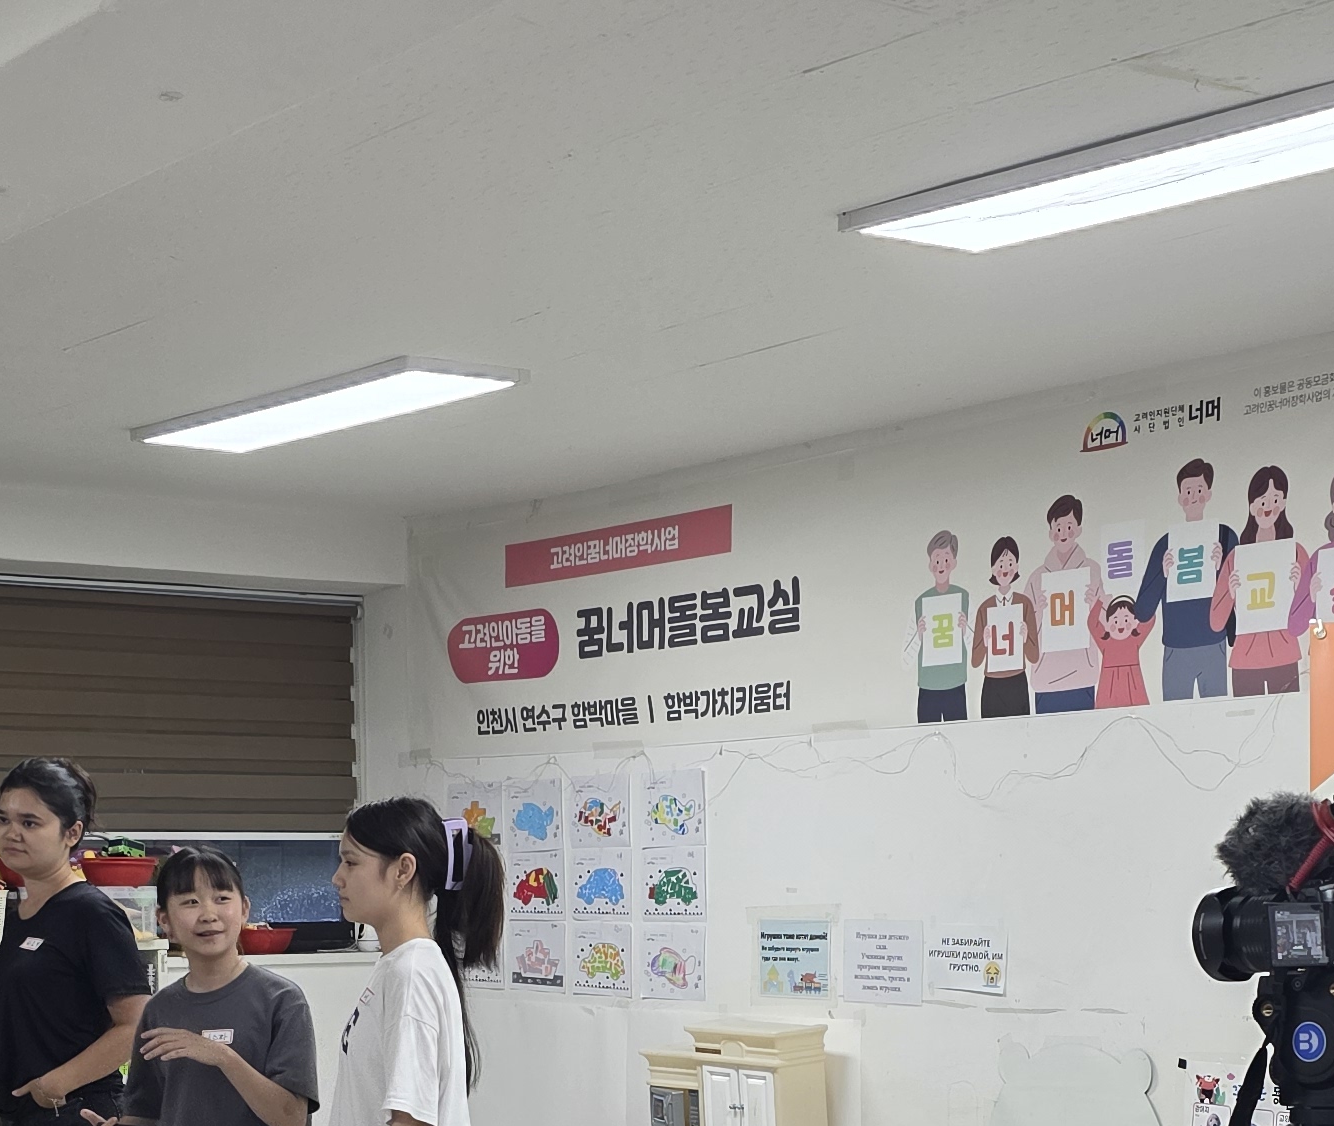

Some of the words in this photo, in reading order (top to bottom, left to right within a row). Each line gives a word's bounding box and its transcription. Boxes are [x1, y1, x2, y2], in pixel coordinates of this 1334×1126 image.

[1188, 396, 1222, 425] 너머
[1090, 424, 1120, 447] 너머
[550, 525, 680, 571] 고려인꿈너머장학사업
[576, 575, 801, 660] 꿈너머돌봄교실
[931, 612, 954, 649] 꿈
[991, 620, 1015, 657] 너
[1050, 590, 1075, 627] 머
[1106, 540, 1134, 581] 돌
[1176, 543, 1205, 586] 봄
[1246, 570, 1276, 611] 교
[458, 615, 546, 650] 고려인아동을
[488, 649, 519, 676] 위한
[476, 706, 518, 736] 인천시
[520, 702, 567, 733] 연수구
[571, 695, 640, 730] 함박마을
[663, 679, 792, 722] 함박가치키움터
